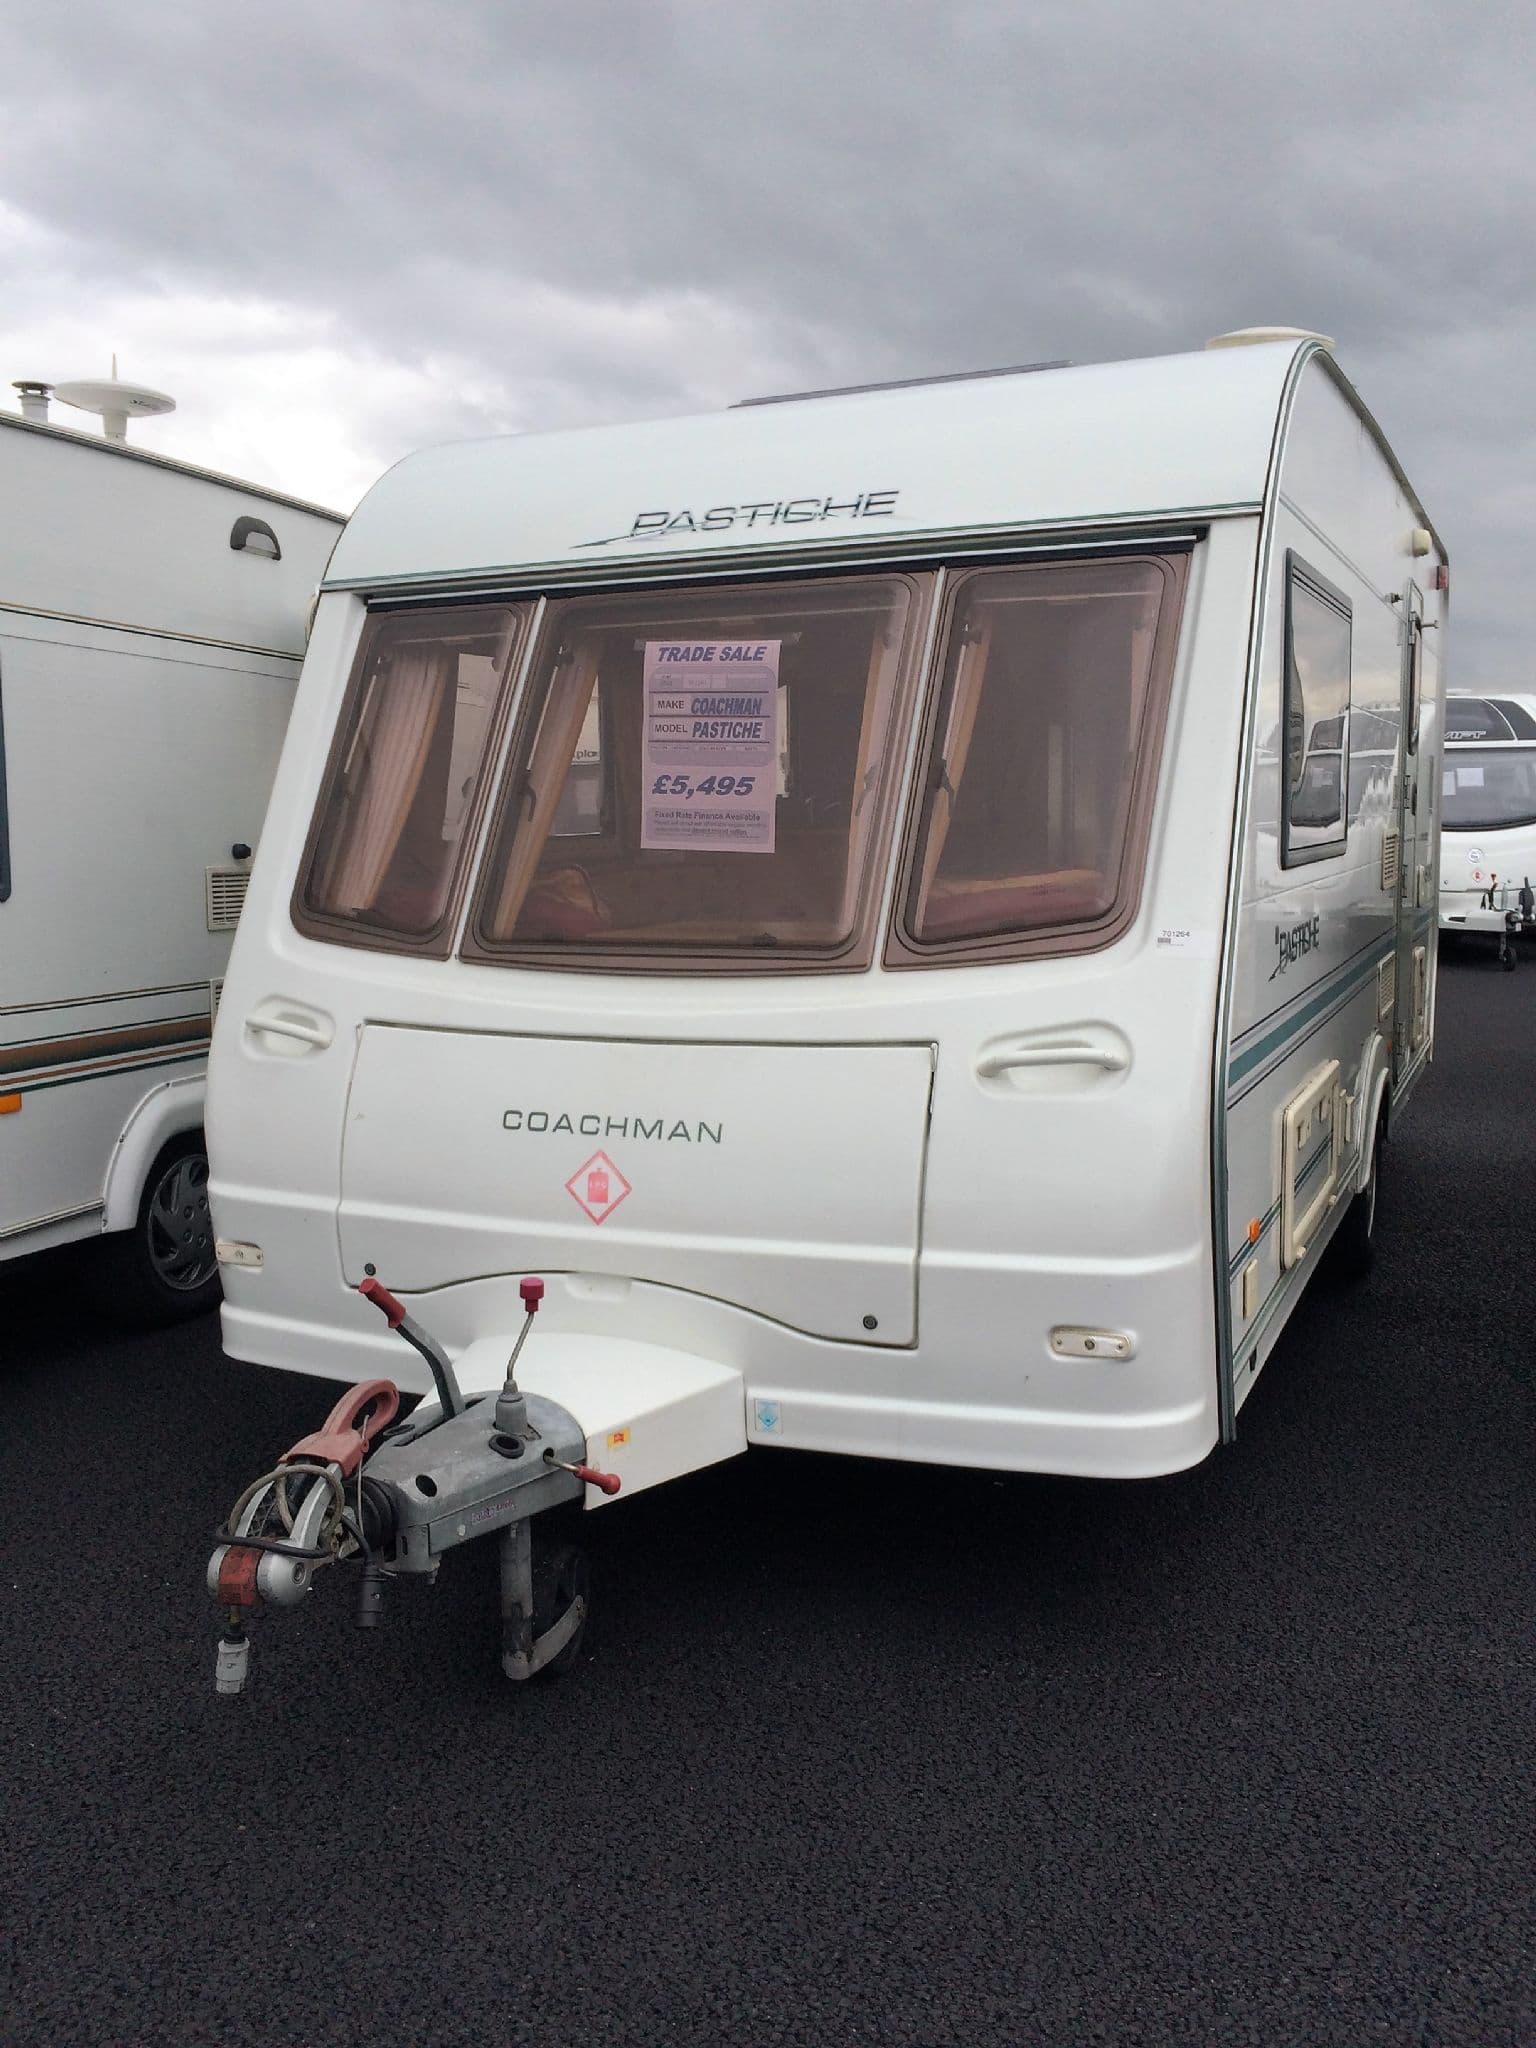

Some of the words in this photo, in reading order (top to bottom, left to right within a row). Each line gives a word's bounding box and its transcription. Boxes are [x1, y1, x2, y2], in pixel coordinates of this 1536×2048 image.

[629, 490, 900, 537] PASTICHE
[657, 646, 716, 662] TRADE
[719, 646, 767, 661] SALE
[657, 700, 685, 709] MAKE
[691, 697, 762, 715] COACHMAN
[654, 724, 688, 733] MODEL
[692, 721, 763, 739] PASTICHE
[651, 774, 756, 800] £5,495
[654, 810, 674, 819] Fixed
[675, 811, 692, 819] Rate
[693, 811, 723, 820] Finance
[725, 812, 761, 822] Available
[1279, 915, 1320, 963] PASTICHE
[502, 1109, 723, 1144] COACHMAN
